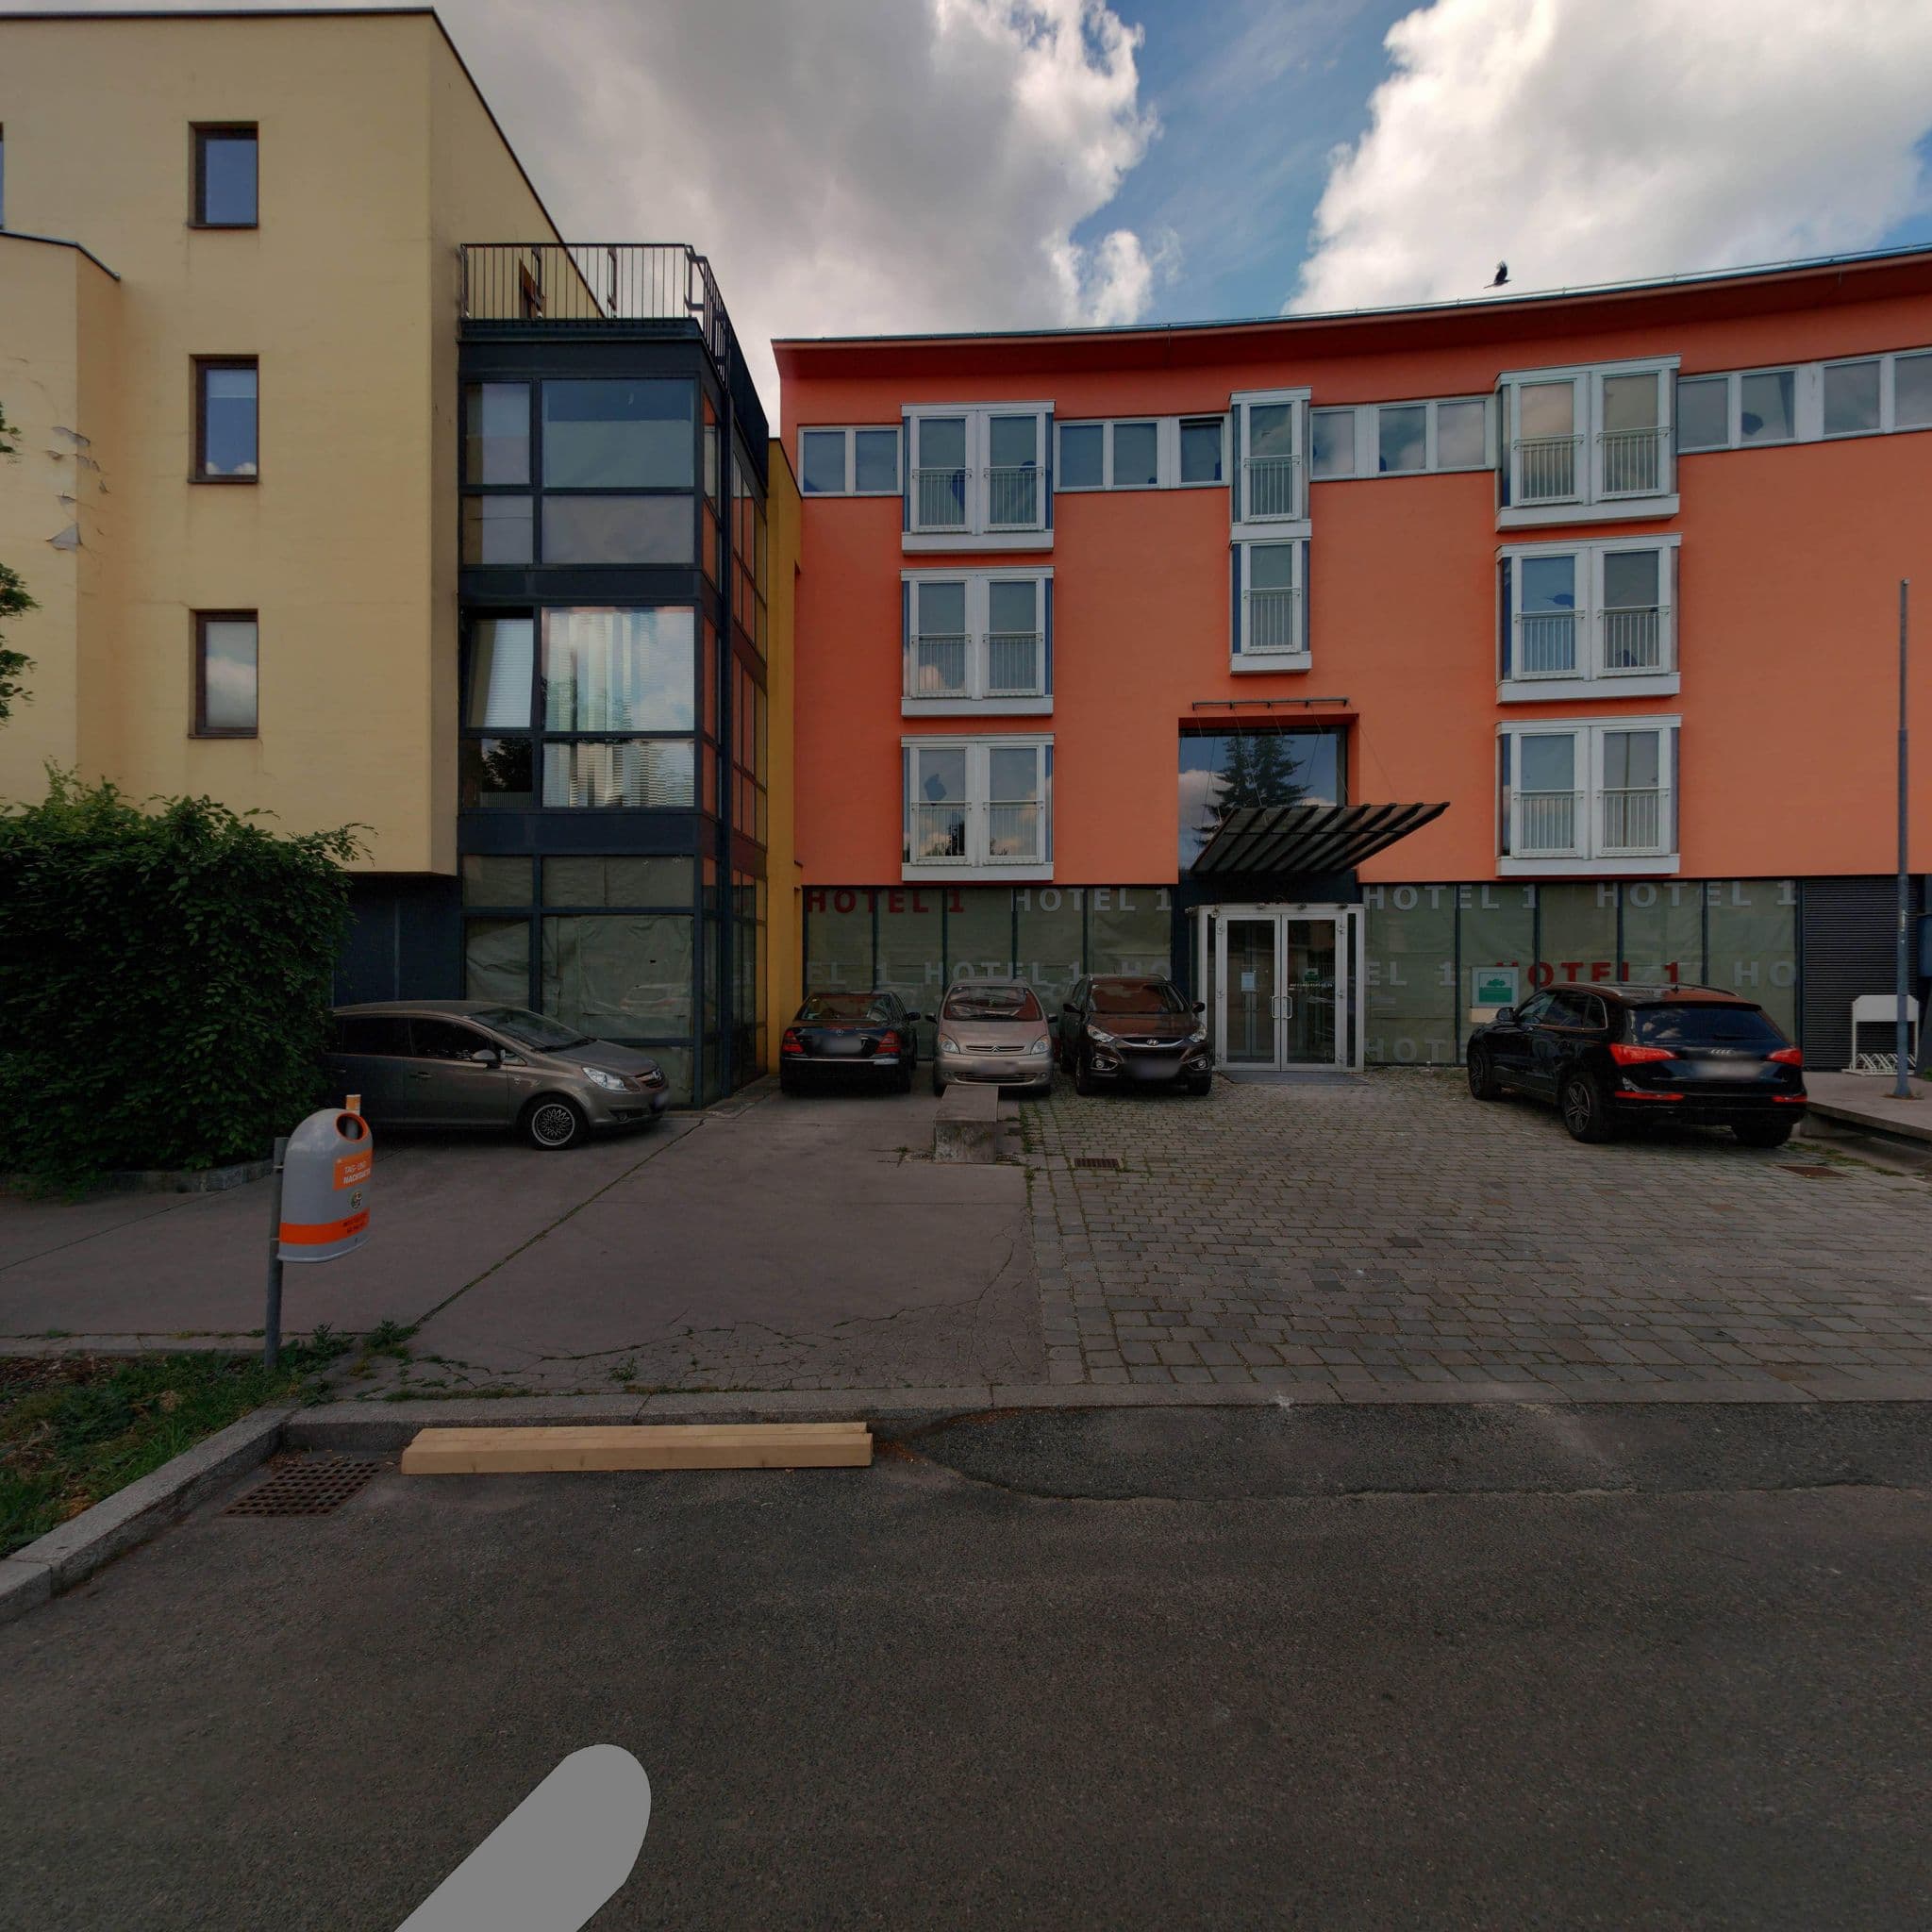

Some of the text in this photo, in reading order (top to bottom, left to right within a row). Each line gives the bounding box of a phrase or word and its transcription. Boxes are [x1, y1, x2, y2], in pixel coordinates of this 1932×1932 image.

[807, 889, 964, 913] HOTEL 1
[1010, 888, 1173, 912] HOTEL 1
[1363, 884, 1537, 910] HOTEL 1
[1596, 882, 1797, 908] HOTEL 1
[1495, 961, 1629, 988] OTEL
